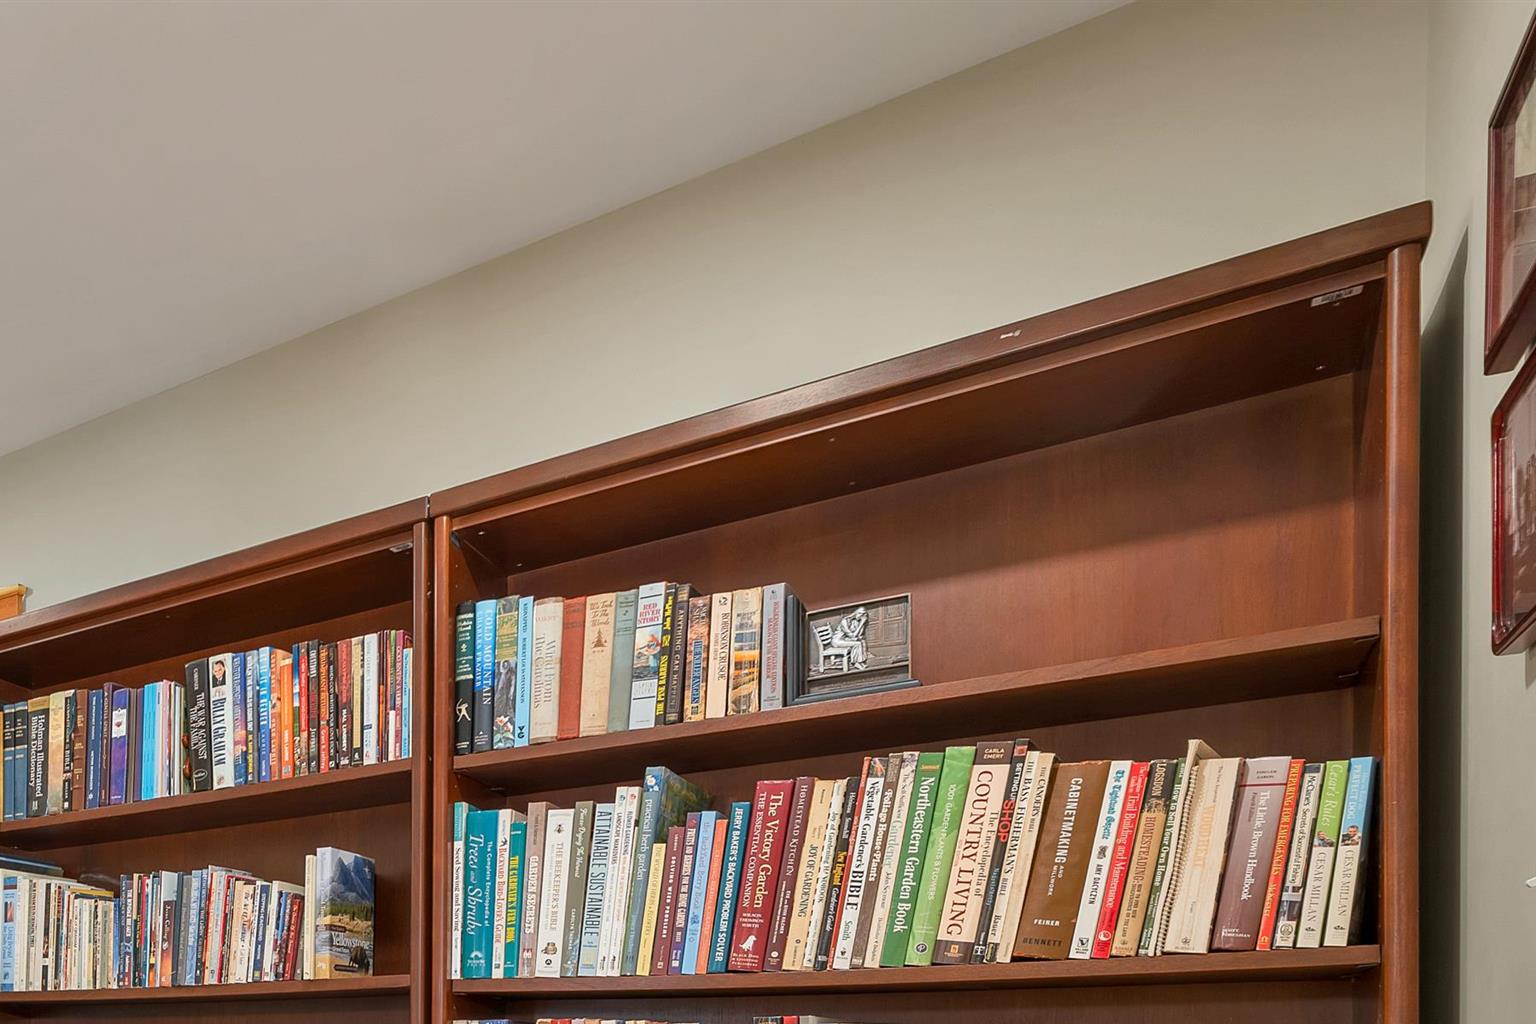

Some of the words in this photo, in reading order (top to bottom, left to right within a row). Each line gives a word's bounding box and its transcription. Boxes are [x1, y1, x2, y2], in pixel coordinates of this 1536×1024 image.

[676, 610, 684, 651] ANYTHING
[719, 613, 729, 649] ROBINSON
[482, 645, 492, 704] MOUNTAIN
[673, 654, 681, 672] CAN
[718, 651, 727, 680] CRUSOE
[670, 675, 679, 705] HAPPEN
[213, 698, 227, 725] BILLY
[37, 715, 45, 750] Holman
[213, 726, 227, 766] GRAHAM
[27, 744, 36, 787] Dictionary
[35, 752, 45, 797] Illustrated
[1010, 763, 1022, 792] SETTING
[1026, 761, 1034, 775] THE
[1151, 763, 1166, 796] LOGSDON
[1326, 764, 1342, 797] Cesar's
[758, 792, 766, 809] THE
[768, 792, 784, 816] The
[863, 781, 878, 821] Vegetable
[1018, 778, 1033, 801] BASS
[1171, 784, 1182, 801] How
[1258, 791, 1270, 806] The
[642, 800, 654, 833] practical
[733, 807, 743, 829] JERRY
[792, 785, 809, 836] HOMESTEAD
[907, 777, 935, 853] Northeastern
[962, 770, 993, 861] COUNTRY
[988, 811, 1000, 827] The
[998, 800, 1015, 843] SHOP
[1055, 778, 1083, 863] CABINETMAKING
[1166, 811, 1177, 826] Sell
[1253, 807, 1267, 829] Little,
[1321, 800, 1337, 826] Rules
[592, 811, 612, 867] ATTAINABLE
[640, 834, 651, 852] herb
[729, 831, 741, 861] BAKER'S
[750, 811, 763, 855] ESSENTIAL
[759, 820, 779, 861] Victory
[854, 823, 871, 869] Gardener's
[1003, 806, 1026, 874] FISHERMAN'S
[1162, 828, 1174, 845] Your
[1248, 831, 1263, 857] Brown
[469, 835, 484, 868] Trees
[786, 838, 798, 876] KITCHEN
[807, 860, 816, 871] OF
[809, 844, 819, 860] JOY
[974, 829, 995, 888] Encyclopedia
[1134, 816, 1156, 884] HOMESTEADING:
[1159, 846, 1170, 863] Own
[1341, 850, 1353, 879] CESAR
[528, 856, 538, 892] GARDEN
[636, 854, 647, 880] garden
[724, 862, 737, 898] BACKYARD
[743, 857, 757, 907] COMPANION
[899, 857, 920, 899] Garden
[1153, 864, 1166, 886] Home
[1240, 859, 1257, 900] Handbook
[1312, 852, 1326, 882] CESAR
[754, 864, 772, 907] Garden
[797, 871, 814, 917] GARDENING
[845, 870, 864, 910] BIBLE
[946, 867, 974, 936] LIVING
[999, 878, 1009, 896] BIBLE
[1337, 882, 1349, 917] MILLAN
[467, 886, 482, 934] Shrubs
[525, 894, 536, 934] SECRETS
[584, 872, 605, 936] SUSTAINABLE
[720, 900, 731, 931] PROBLEM
[893, 902, 909, 933] Book
[1307, 885, 1321, 922] MILLAN
[841, 920, 853, 941] Smith
[990, 915, 1002, 936] Bauer
[715, 933, 725, 961] SOLVER
